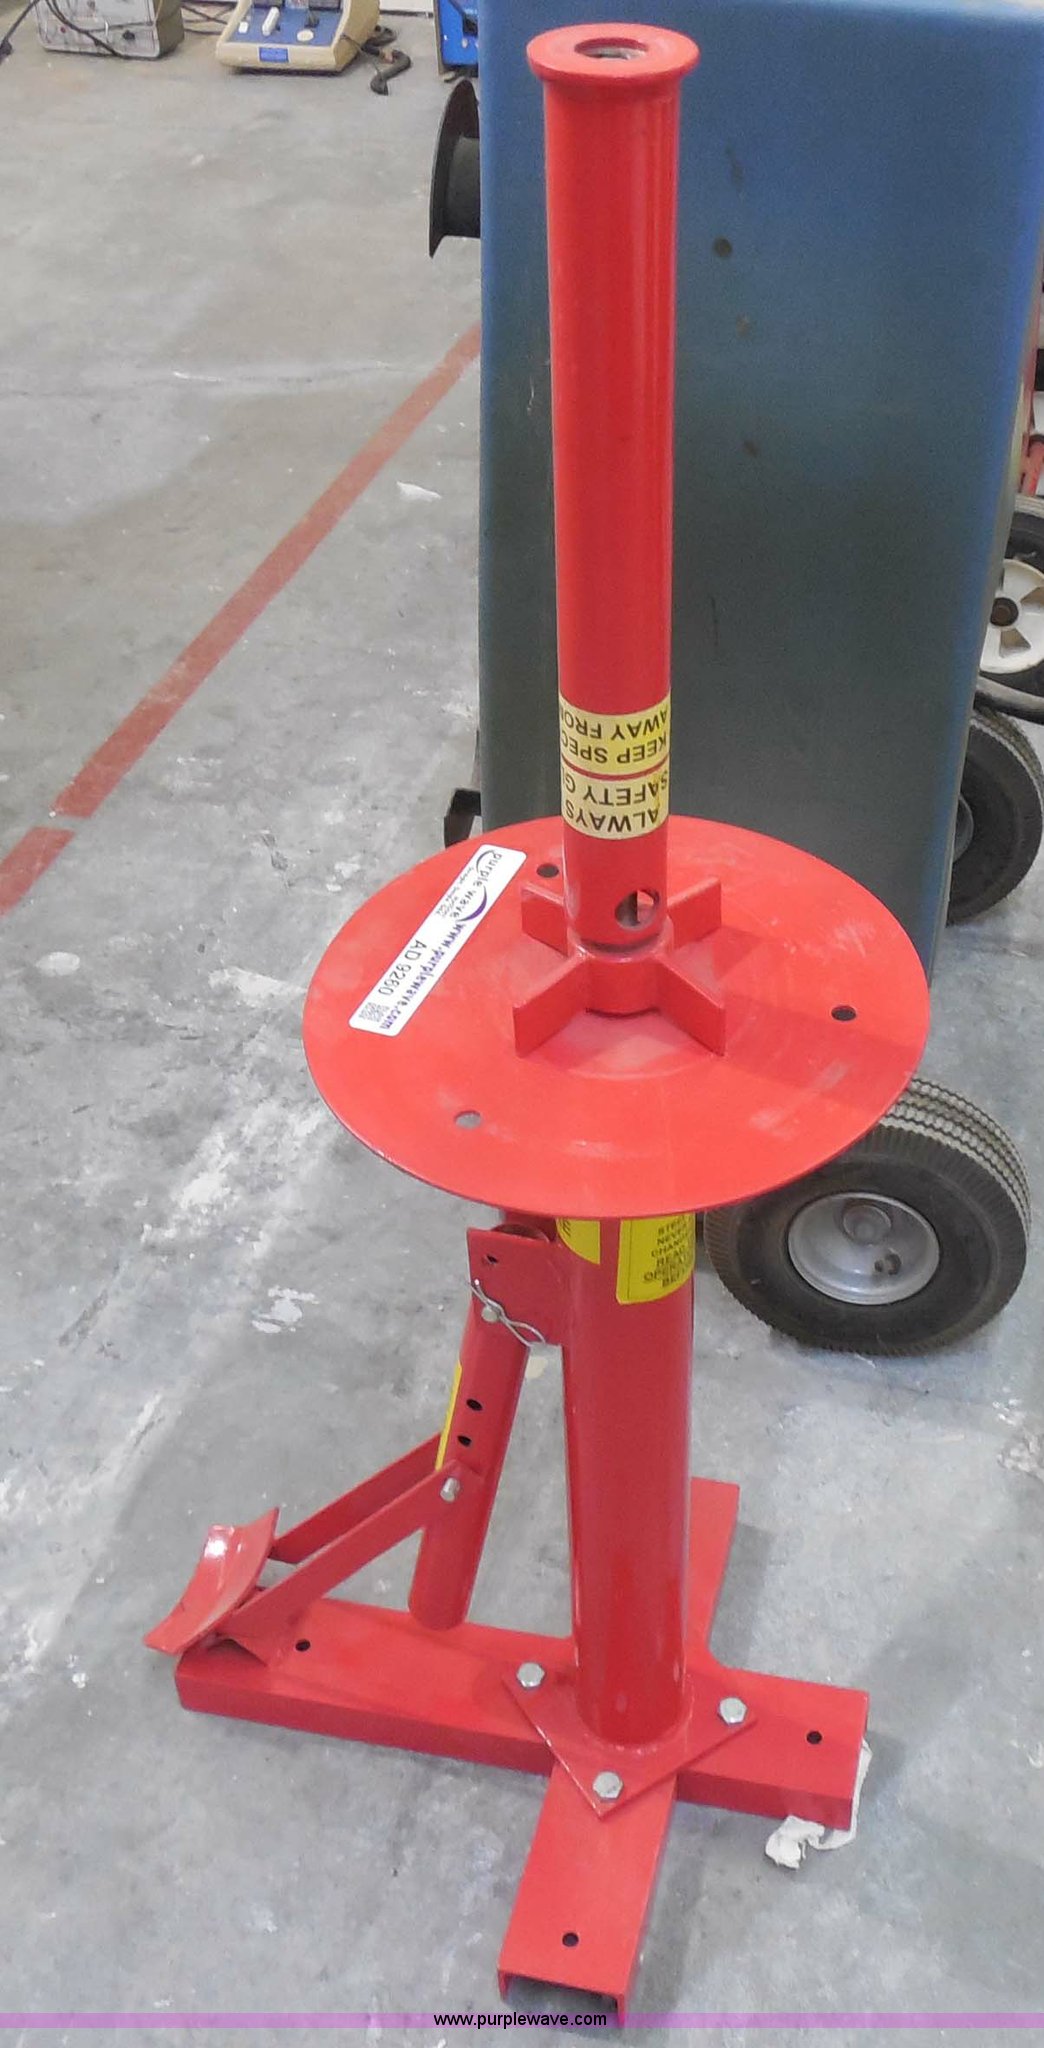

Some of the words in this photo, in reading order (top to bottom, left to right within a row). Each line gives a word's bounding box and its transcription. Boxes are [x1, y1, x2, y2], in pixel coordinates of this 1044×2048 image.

[610, 705, 668, 741] AWAY
[561, 730, 608, 764] SPEC
[617, 731, 667, 764] KEEP
[561, 767, 576, 794] G
[583, 770, 668, 807] SAFETY
[566, 799, 660, 833] ALWAYS
[472, 852, 503, 889] purple
[451, 886, 477, 919] wave
[404, 939, 427, 961] AD
[380, 922, 466, 1030] www.purplewave.com
